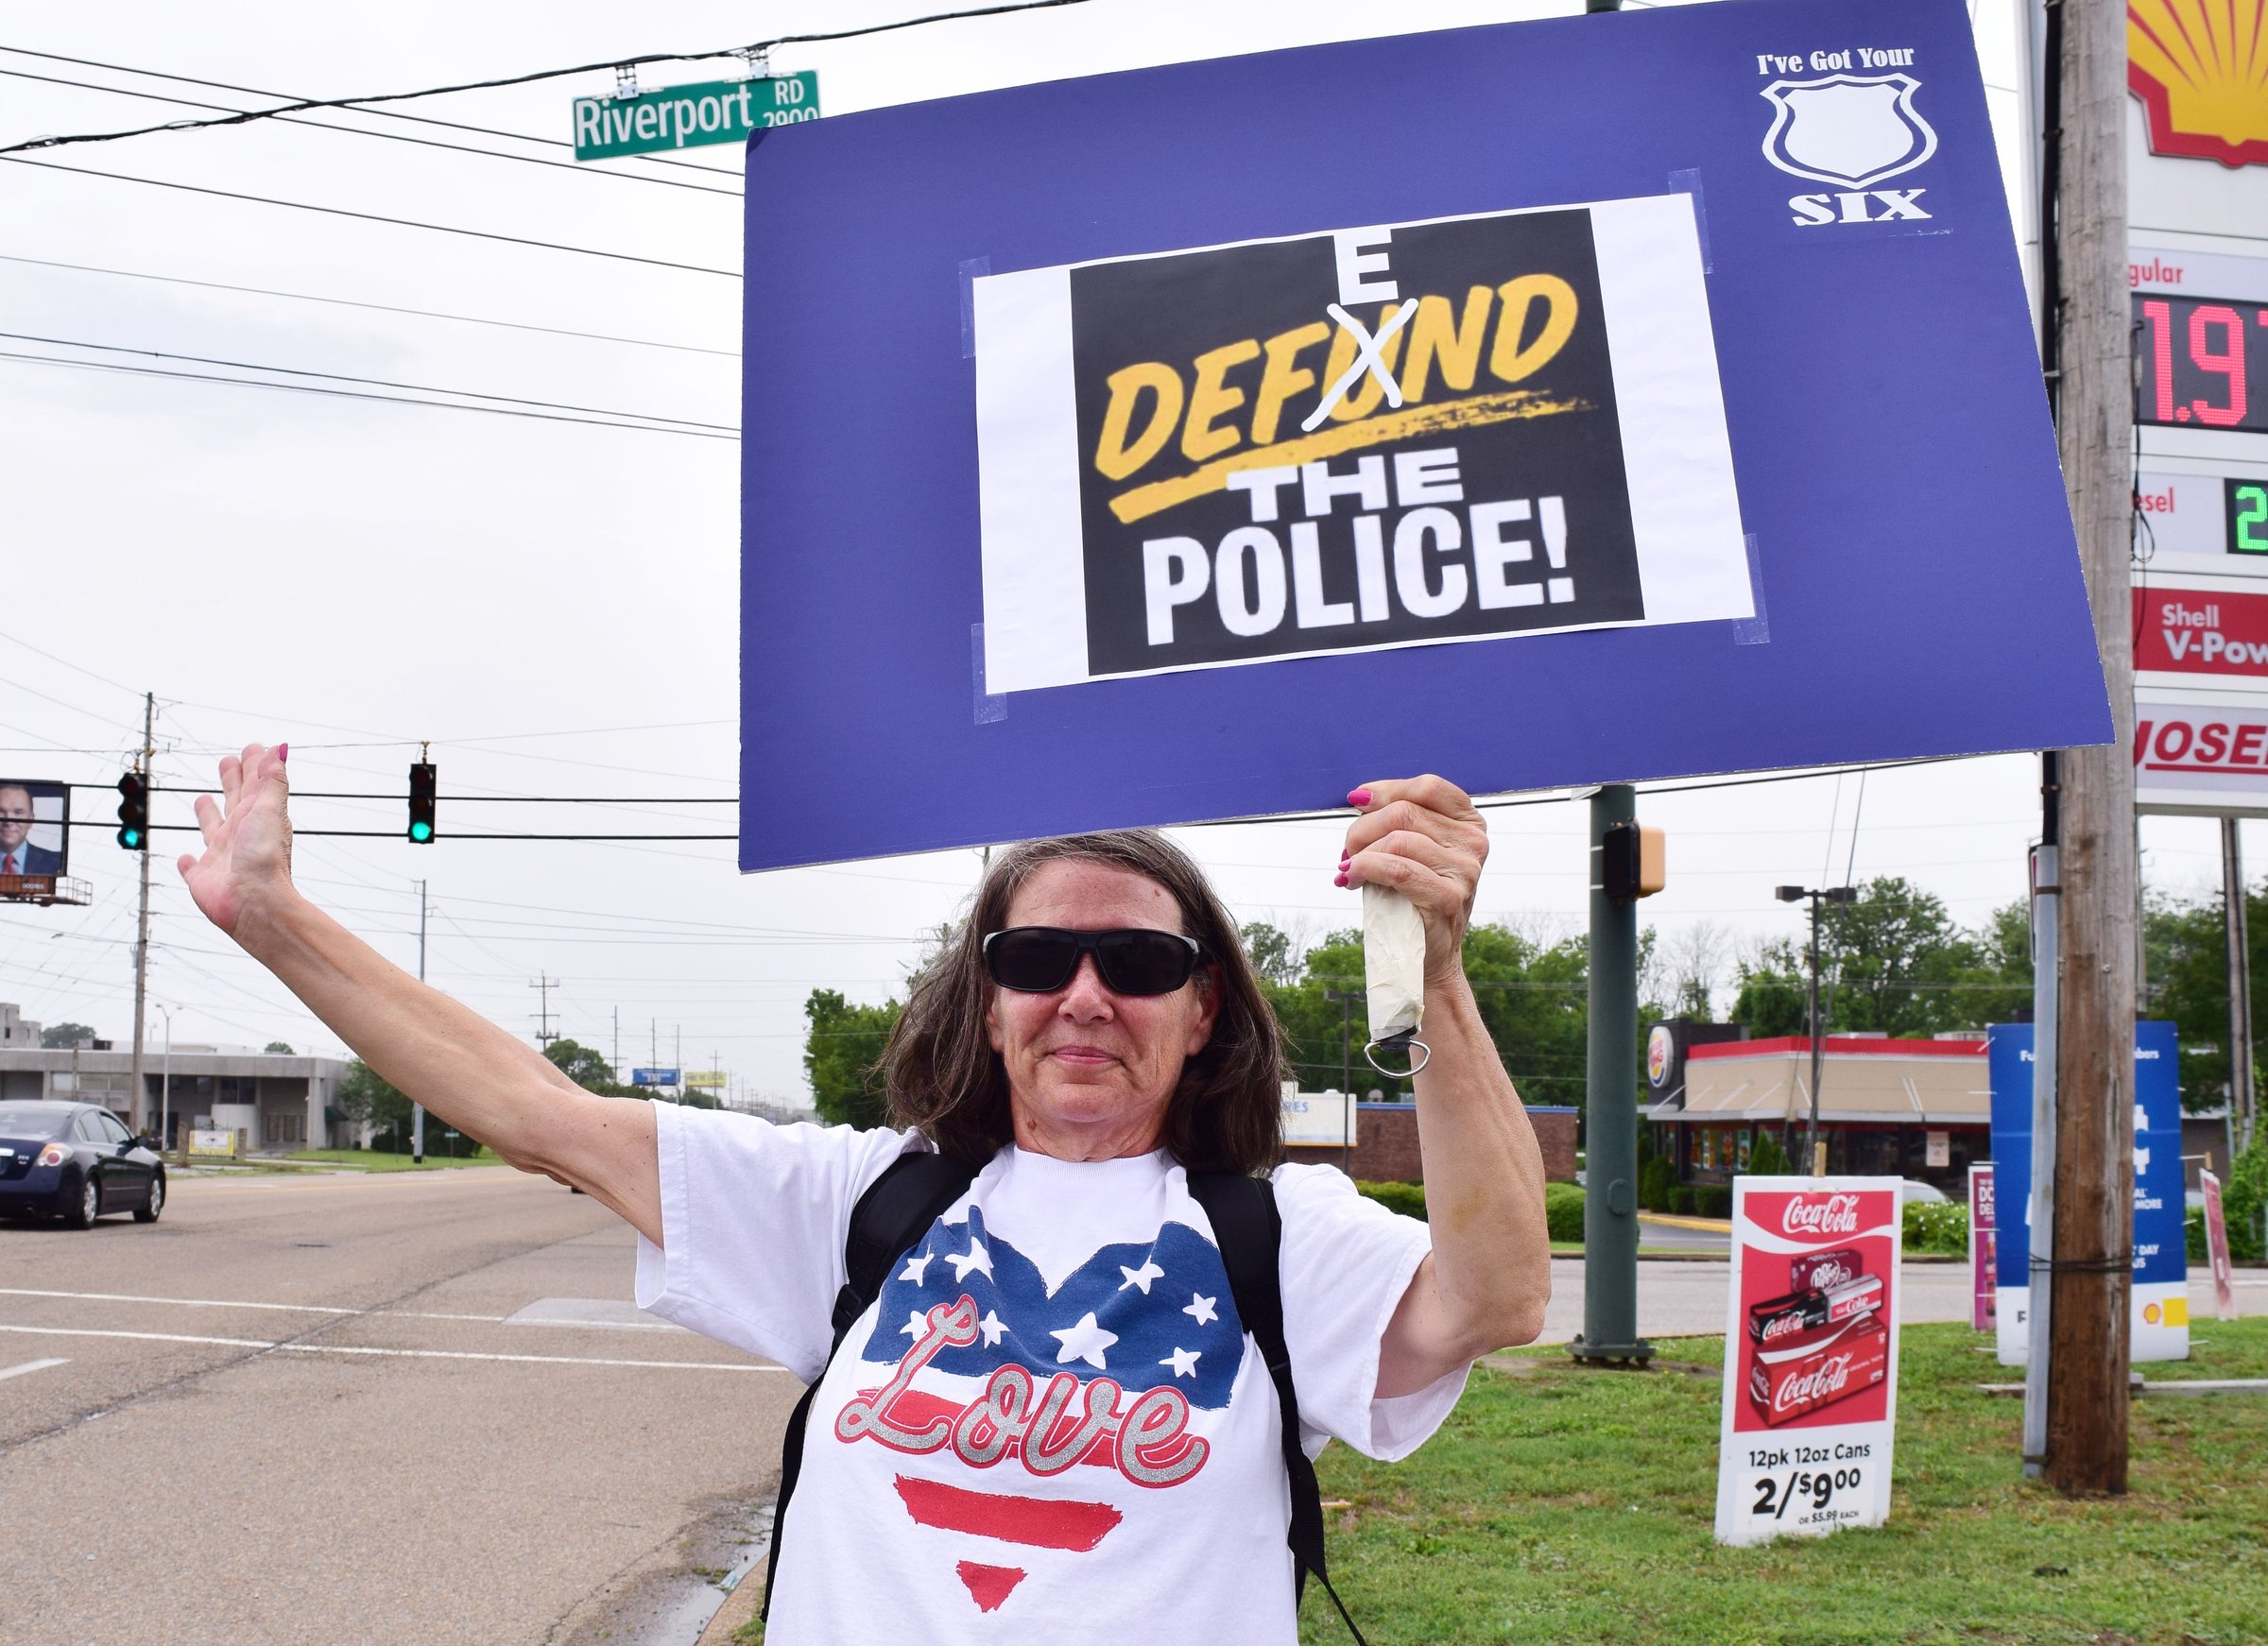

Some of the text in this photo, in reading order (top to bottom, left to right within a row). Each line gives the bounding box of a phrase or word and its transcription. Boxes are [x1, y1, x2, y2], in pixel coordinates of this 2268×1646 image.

[1756, 47, 1916, 76] I've Got Your
[576, 79, 805, 148] Riverport RD
[1788, 188, 1933, 227] SIX
[1226, 447, 1464, 523] THE
[1142, 495, 1576, 646] POLICE!
[2162, 603, 2220, 628] Shell
[2134, 720, 2268, 767] JOSE
[1782, 1193, 1860, 1234] Coca-Cola
[834, 1294, 1211, 1489] Love
[1774, 1351, 1854, 1413] Coca-Cola
[1749, 1443, 1871, 1469] 12pk 12oz Cans
[1812, 1510, 1838, 1523] $5.99
[1840, 1510, 1860, 1519] EACH
